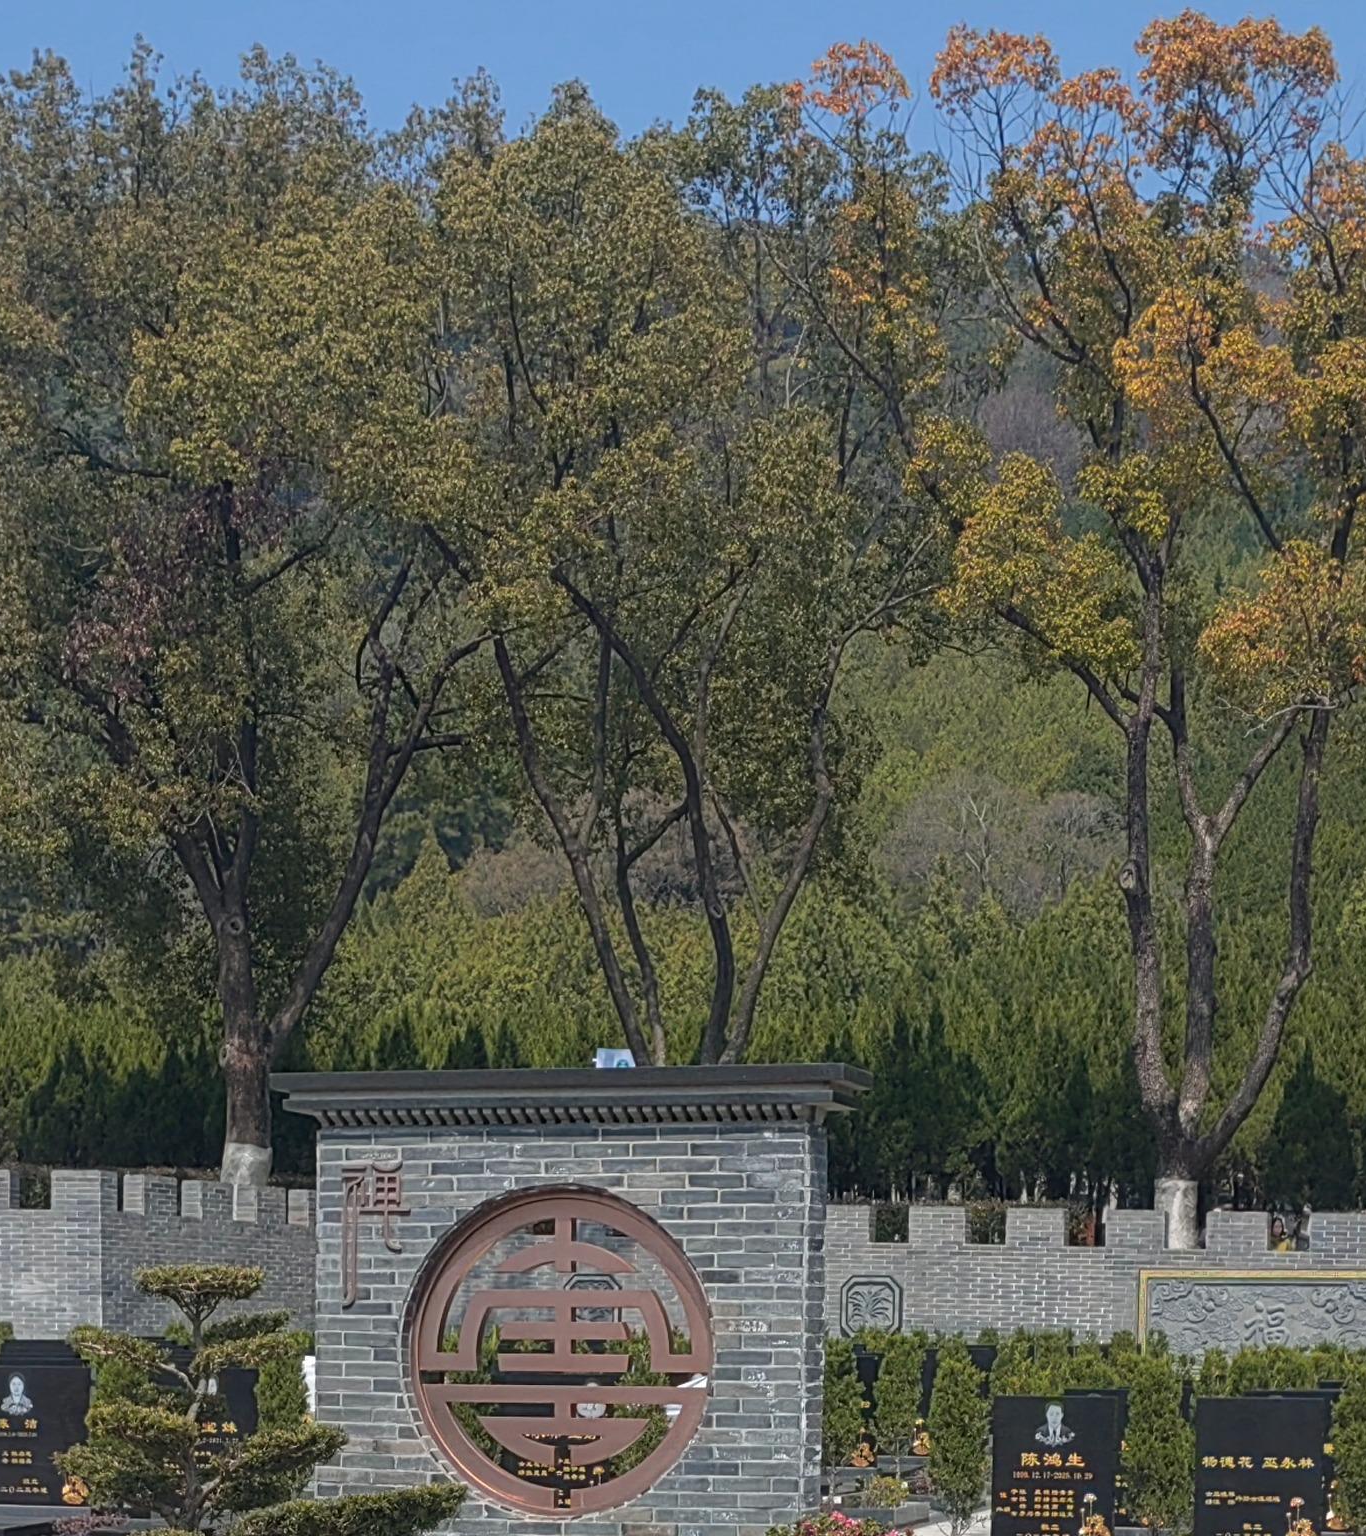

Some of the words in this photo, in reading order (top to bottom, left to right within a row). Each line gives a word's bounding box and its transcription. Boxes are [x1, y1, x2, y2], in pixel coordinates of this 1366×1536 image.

[1020, 1452, 1086, 1468] 陈鸿生
[1261, 1456, 1315, 1469] 巫永林
